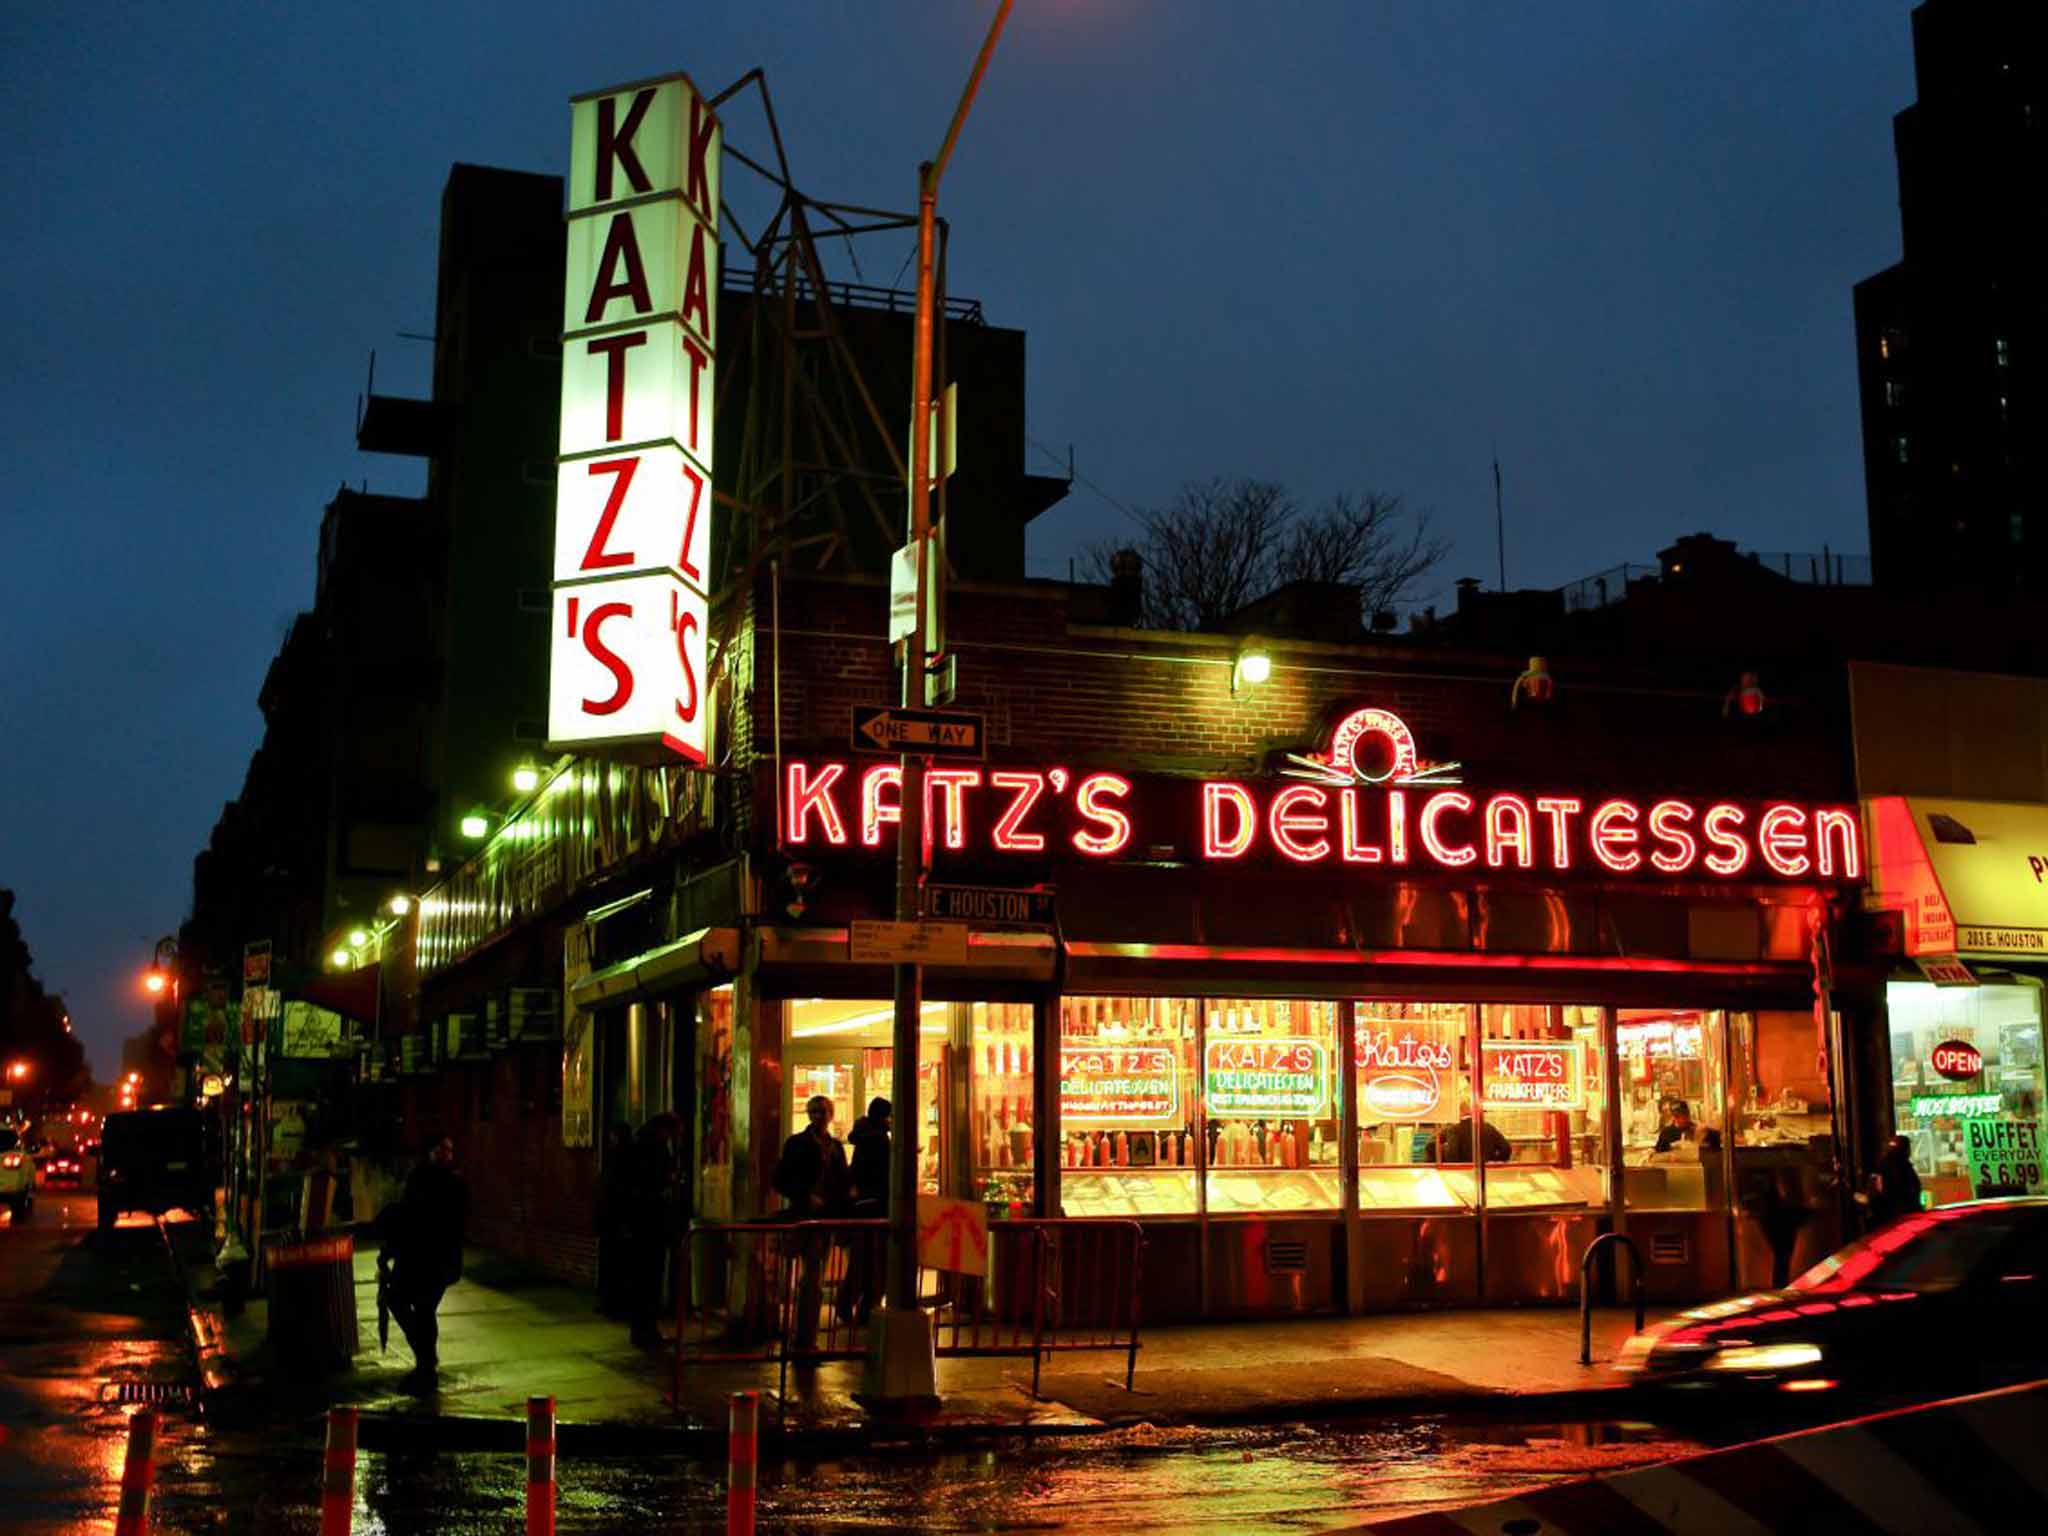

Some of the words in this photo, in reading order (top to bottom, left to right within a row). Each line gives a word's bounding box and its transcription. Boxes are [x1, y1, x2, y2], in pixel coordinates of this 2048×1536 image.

[568, 88, 657, 716] KATZ'S
[671, 94, 716, 724] KATZ'S
[873, 721, 909, 740] ONE
[928, 723, 966, 744] WAY
[787, 762, 1132, 854] KATZ'S
[1202, 781, 1861, 878] DELICATESSEN
[931, 889, 943, 916] E
[951, 890, 1030, 920] HOUSTON
[1998, 931, 2044, 948] HOUSTON
[1497, 1052, 1563, 1077] KATZ'S
[1935, 1050, 1979, 1072] OPEN
[1969, 1122, 2038, 1149] BUFFET
[1973, 1150, 2041, 1162] EVERYDAY
